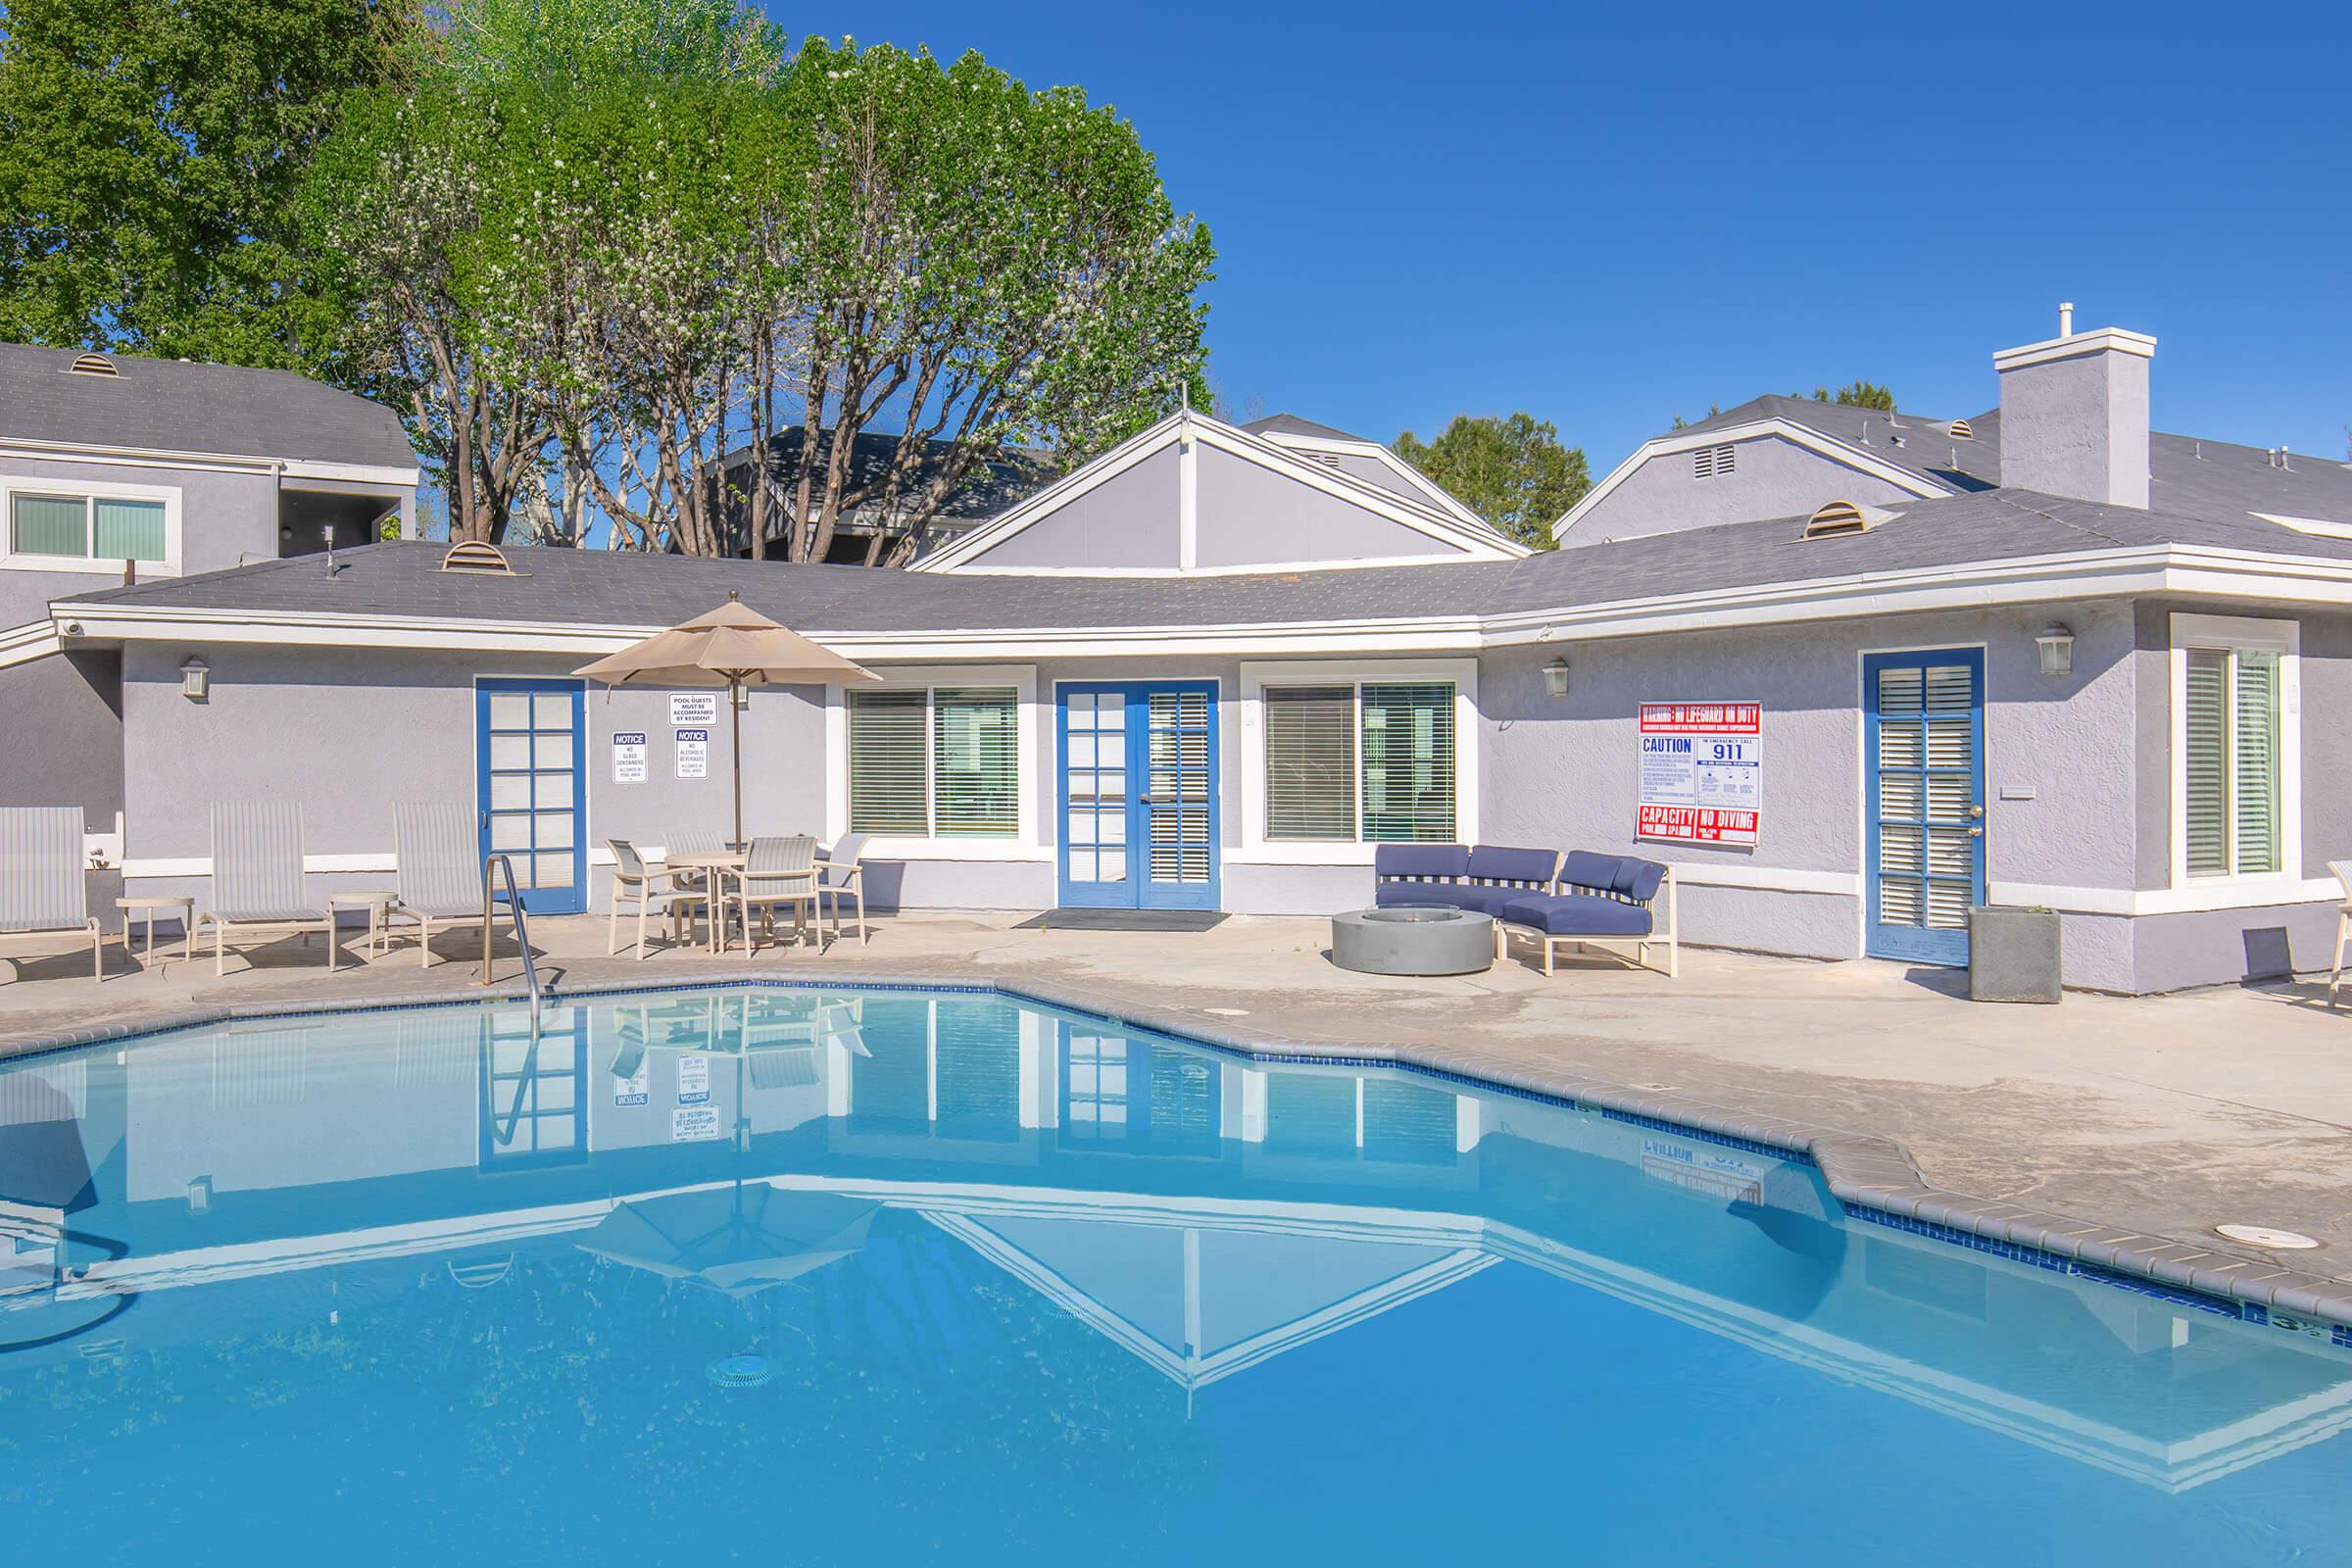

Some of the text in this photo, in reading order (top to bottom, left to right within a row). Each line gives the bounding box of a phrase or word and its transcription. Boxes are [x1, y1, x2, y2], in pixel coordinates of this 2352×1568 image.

[1686, 706, 1723, 723] LIFEGUARD
[1725, 706, 1736, 723] ON
[1738, 706, 1757, 723] DUTY
[615, 735, 644, 744] NOTICE
[678, 731, 706, 740] NOTICE
[1642, 738, 1691, 753] CAUTION
[1713, 744, 1741, 760] 911
[1642, 807, 1694, 825] CAPACITY
[1700, 810, 1753, 829] NO DIVING
